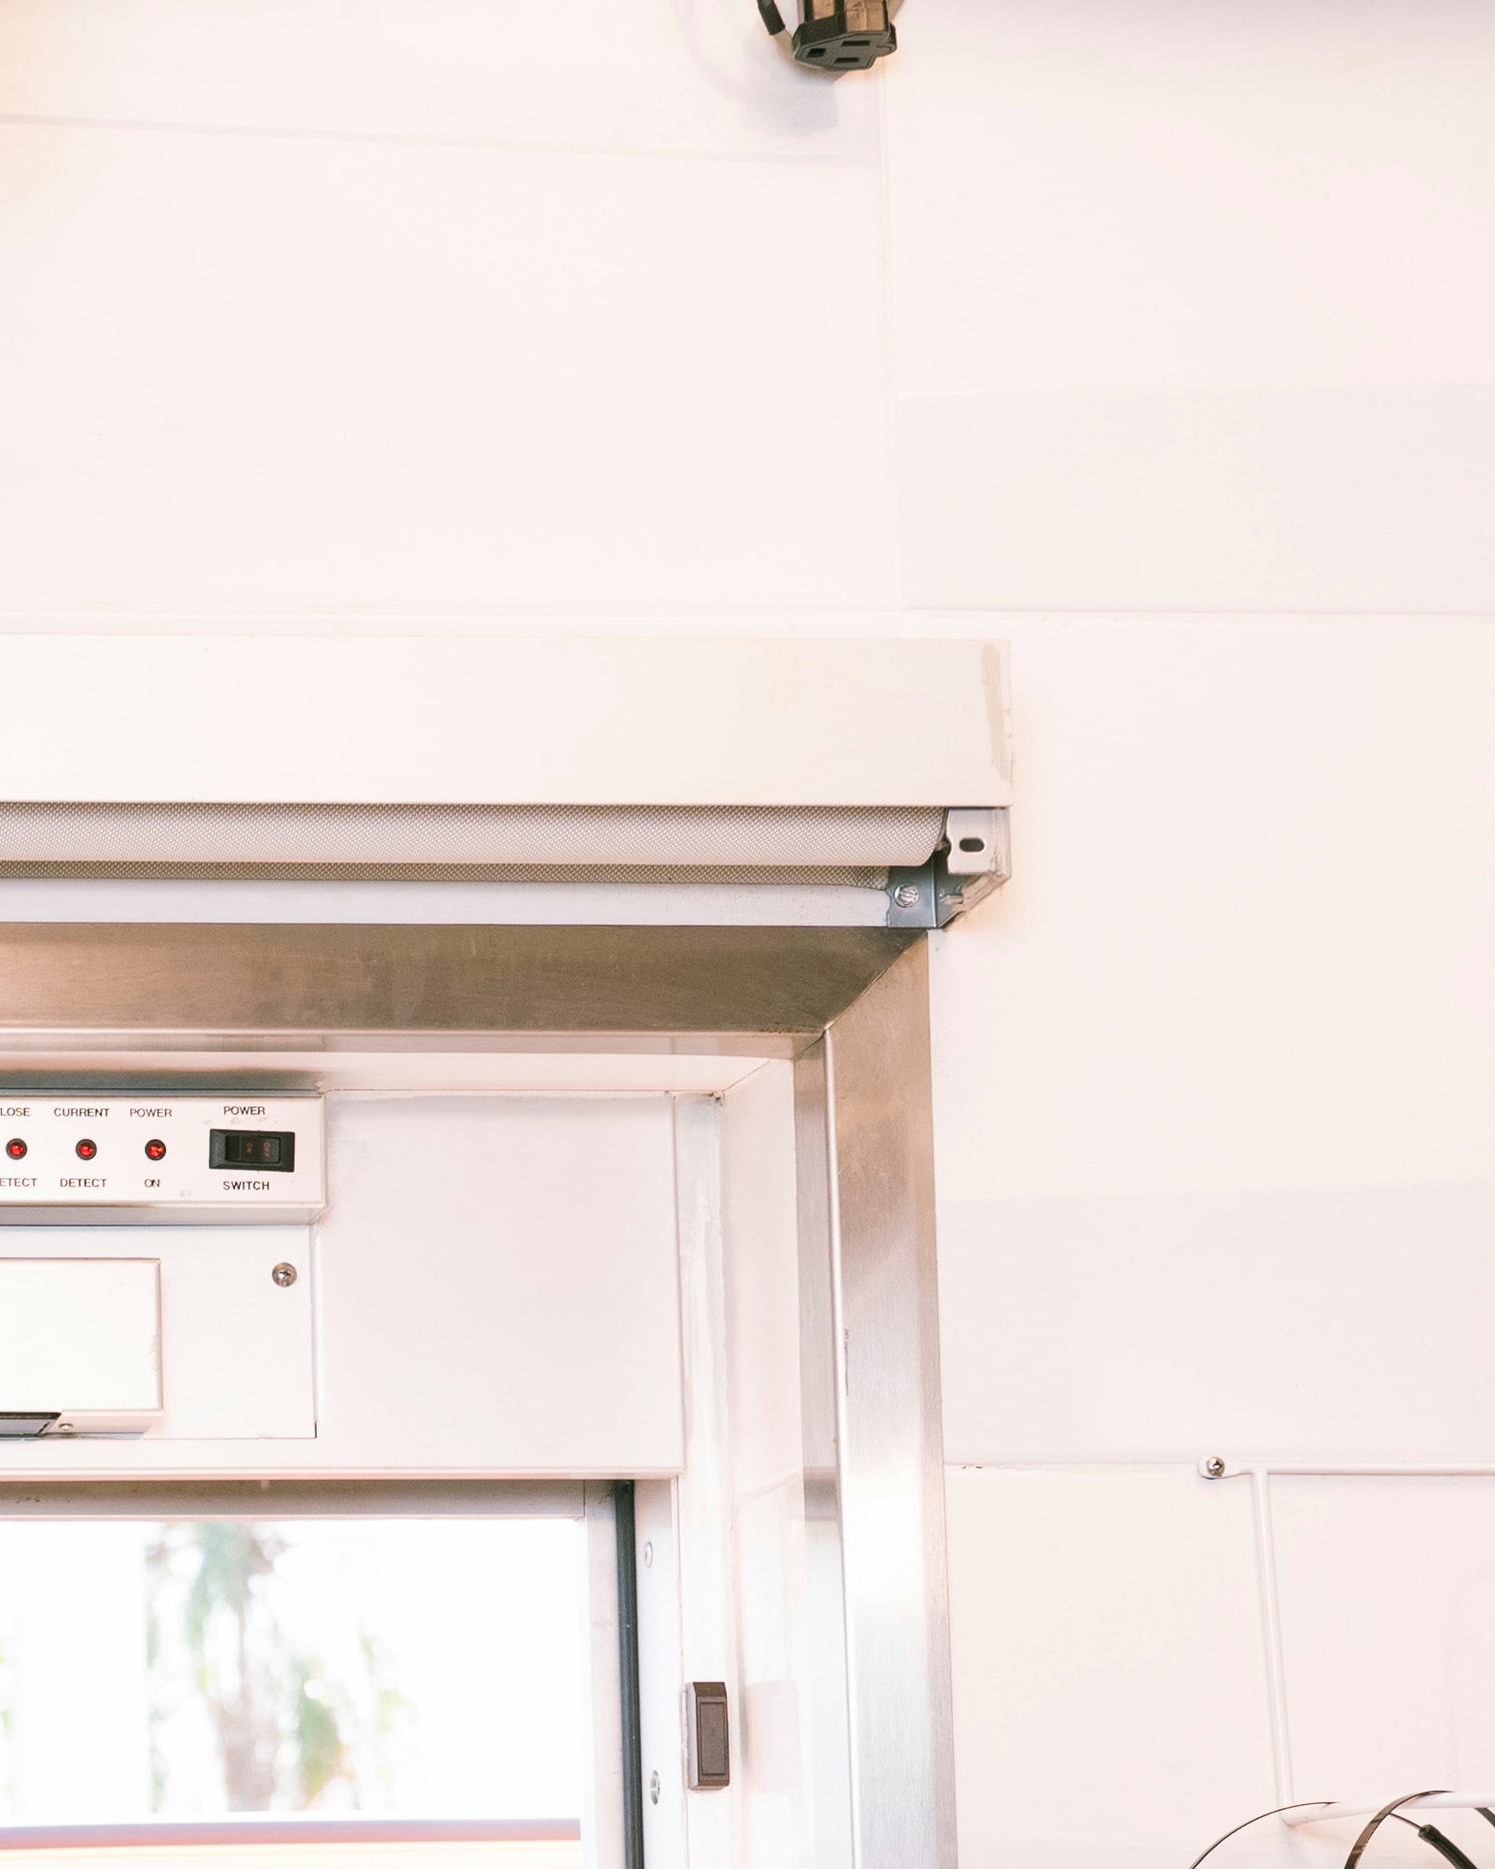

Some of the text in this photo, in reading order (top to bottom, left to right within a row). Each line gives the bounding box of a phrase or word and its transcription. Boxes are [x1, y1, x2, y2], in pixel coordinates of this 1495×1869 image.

[54, 1107, 110, 1117] CURRENT
[129, 1108, 173, 1118] POWER
[223, 1106, 266, 1116] POWER
[59, 1178, 108, 1188] DETECT
[144, 1178, 161, 1188] ON
[222, 1180, 270, 1191] SWITCH
